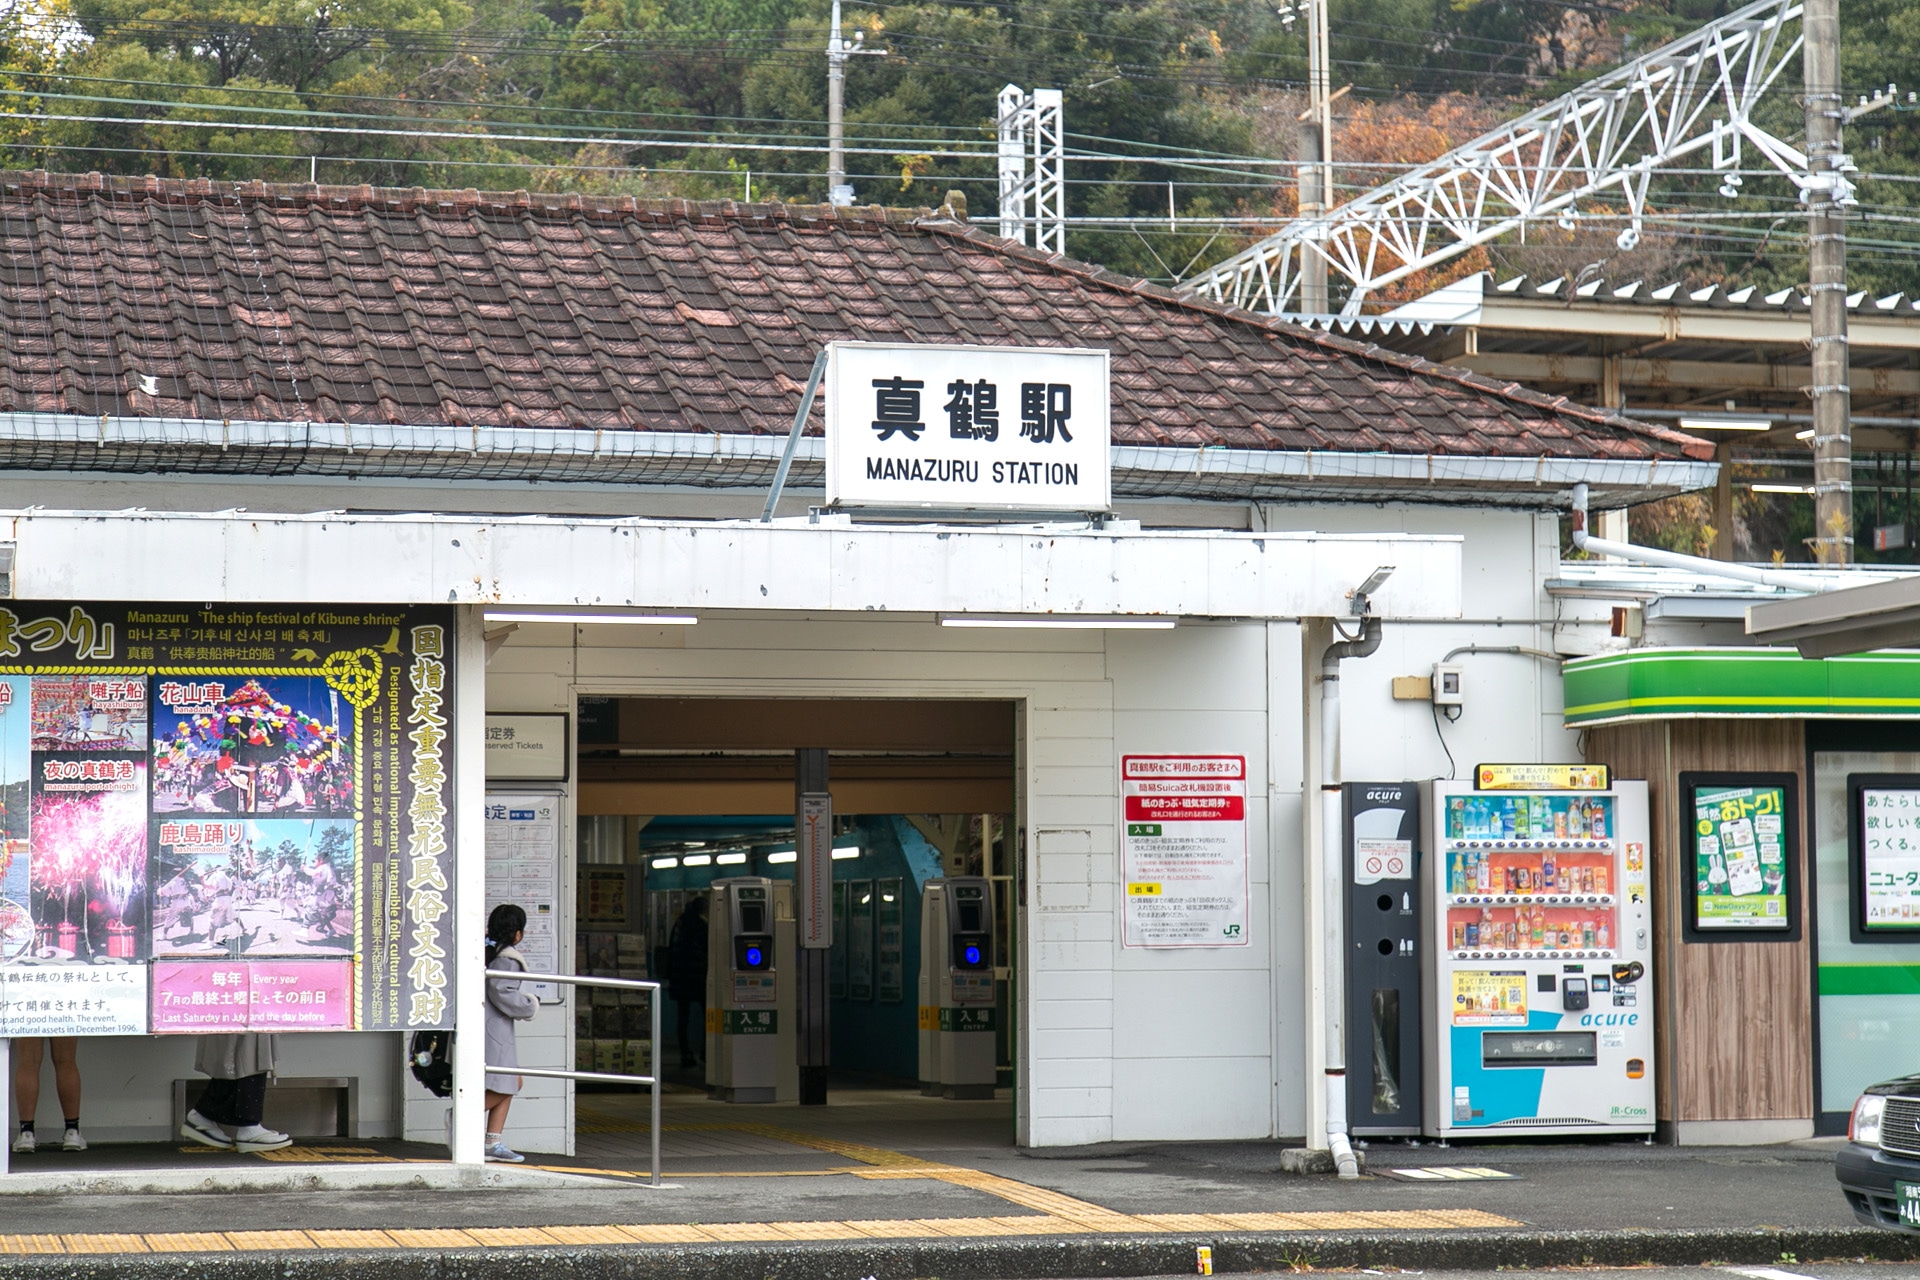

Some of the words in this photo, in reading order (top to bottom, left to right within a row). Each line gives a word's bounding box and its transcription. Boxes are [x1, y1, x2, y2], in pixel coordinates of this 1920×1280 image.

[871, 376, 1073, 443] 真鶴駅
[867, 457, 978, 482] MANAZURU
[992, 461, 1078, 485] STATION
[128, 611, 189, 624] Manazuru
[227, 612, 253, 628] ship
[256, 611, 300, 625] festival
[303, 611, 318, 626] of
[318, 612, 361, 626] Kibune
[91, 682, 144, 700] 囃子船
[160, 684, 224, 704] 花山車
[388, 666, 402, 730] Designated
[92, 702, 143, 711] hayashibune
[390, 733, 399, 745] as
[45, 761, 133, 779] 夜の真鶴港
[390, 748, 402, 794] national
[1129, 762, 1239, 773] 真鶴駅をご利用のお客さまへ
[86, 784, 103, 794] port
[114, 783, 135, 793] night
[1139, 783, 1231, 792] 簡易Suica改札機設置後
[1366, 790, 1402, 800] acure
[1141, 798, 1231, 808] 紙のきっぷ・磁気定期券で
[388, 796, 401, 853] important
[408, 624, 448, 1026] 国指定重要無形民俗文化財
[1134, 826, 1154, 834] 入場
[160, 824, 243, 844] 鹿島踊り
[174, 846, 227, 854] kashimaodori
[1868, 838, 1917, 851] つくる。
[1869, 871, 1920, 886] ニュータ
[388, 859, 401, 916] intangible
[1135, 886, 1154, 894] 出場
[390, 919, 401, 941] folk
[1223, 924, 1241, 936] JR
[390, 943, 401, 987] cultural
[211, 971, 242, 987] 毎年
[253, 974, 278, 987] Every
[280, 975, 298, 987] year
[161, 991, 326, 1006] 7月の最終土曜日とその前日
[390, 990, 400, 1027] assets.
[960, 1009, 989, 1022] 入場
[26, 1015, 47, 1025] good
[48, 1014, 75, 1023] health.
[77, 1014, 91, 1022] The
[93, 1015, 116, 1024] event,
[162, 1013, 181, 1023] Last
[183, 1013, 219, 1025] Saturday
[222, 1013, 230, 1022] in
[232, 1013, 247, 1025] July
[249, 1013, 264, 1023] and
[266, 1013, 280, 1023] the
[282, 1013, 297, 1025] day
[298, 1013, 325, 1023] before
[740, 1011, 770, 1025] 入場
[1580, 1013, 1639, 1026] acure
[41, 1025, 65, 1034] assets
[76, 1025, 116, 1034] December
[118, 1024, 138, 1034] 1996.
